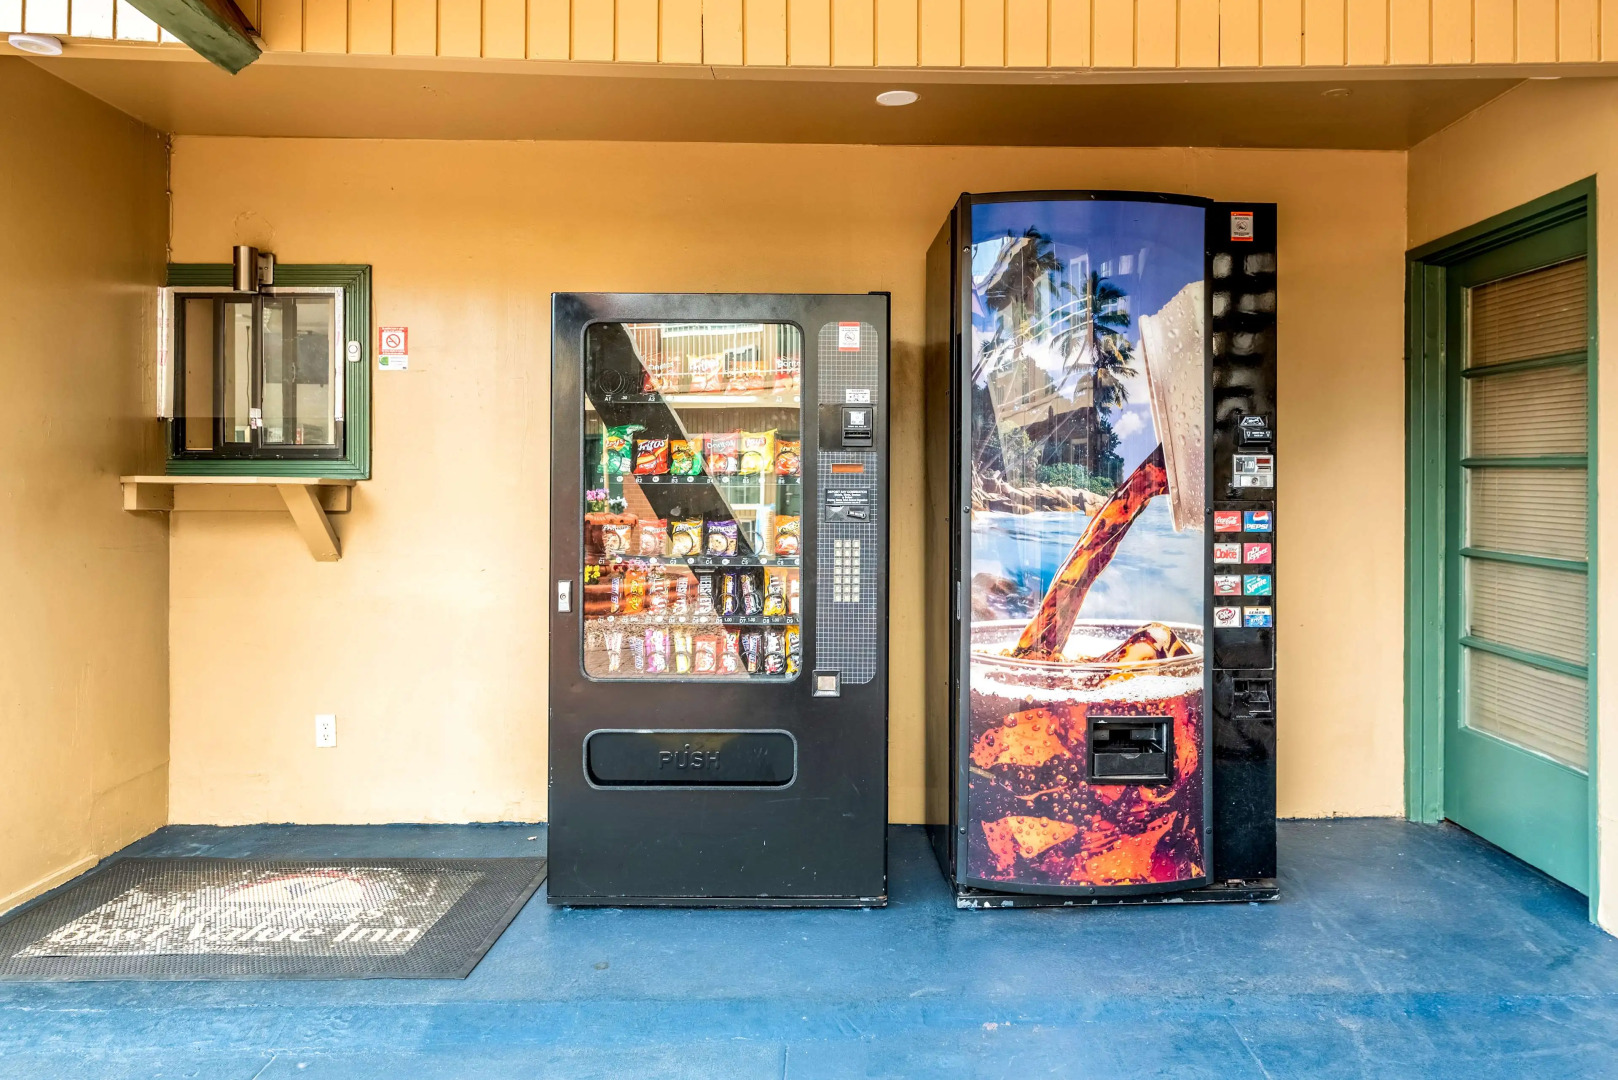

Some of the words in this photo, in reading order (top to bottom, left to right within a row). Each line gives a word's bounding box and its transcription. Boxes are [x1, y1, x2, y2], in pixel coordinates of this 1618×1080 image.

[638, 440, 665, 452] Fritos
[1215, 549, 1237, 559] Coke
[1246, 578, 1267, 594] Sprite
[50, 923, 173, 942] Best
[184, 922, 326, 942] Value
[332, 922, 420, 942] Inn
